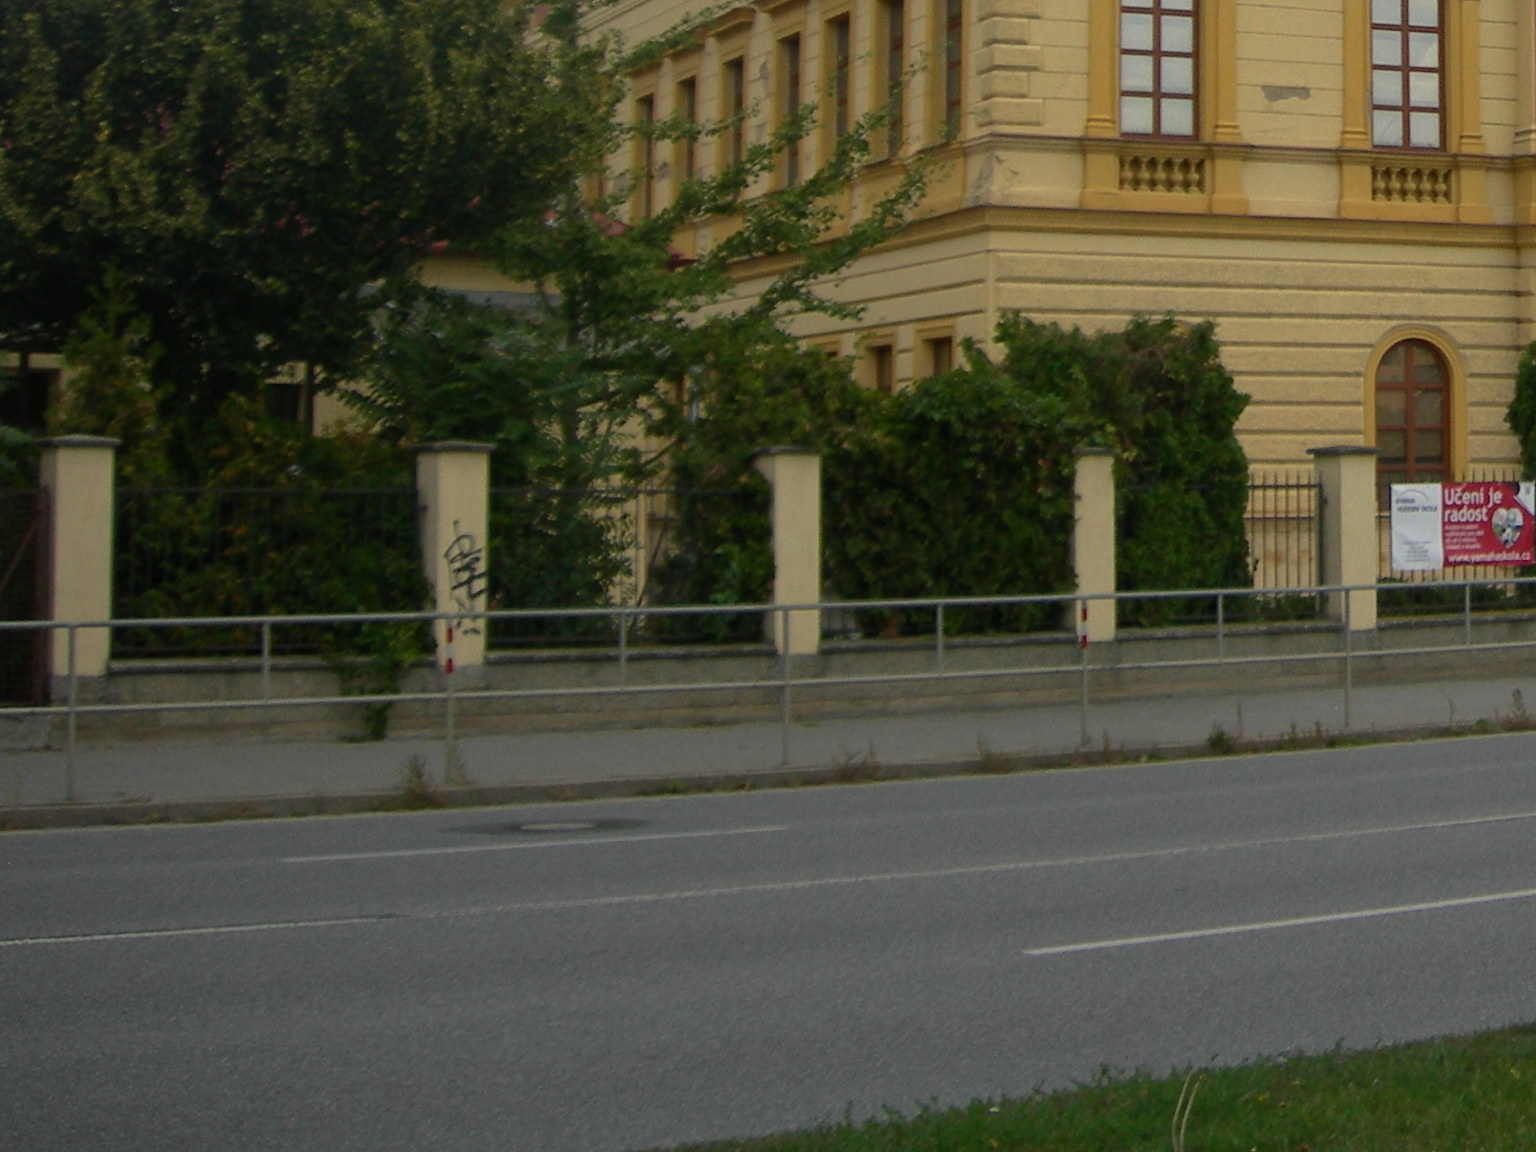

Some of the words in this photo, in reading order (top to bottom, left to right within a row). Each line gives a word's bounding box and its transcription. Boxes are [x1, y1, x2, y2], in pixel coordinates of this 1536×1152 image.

[1444, 486, 1485, 505] Učení
[1487, 486, 1503, 508] je
[1444, 506, 1488, 523] radost
